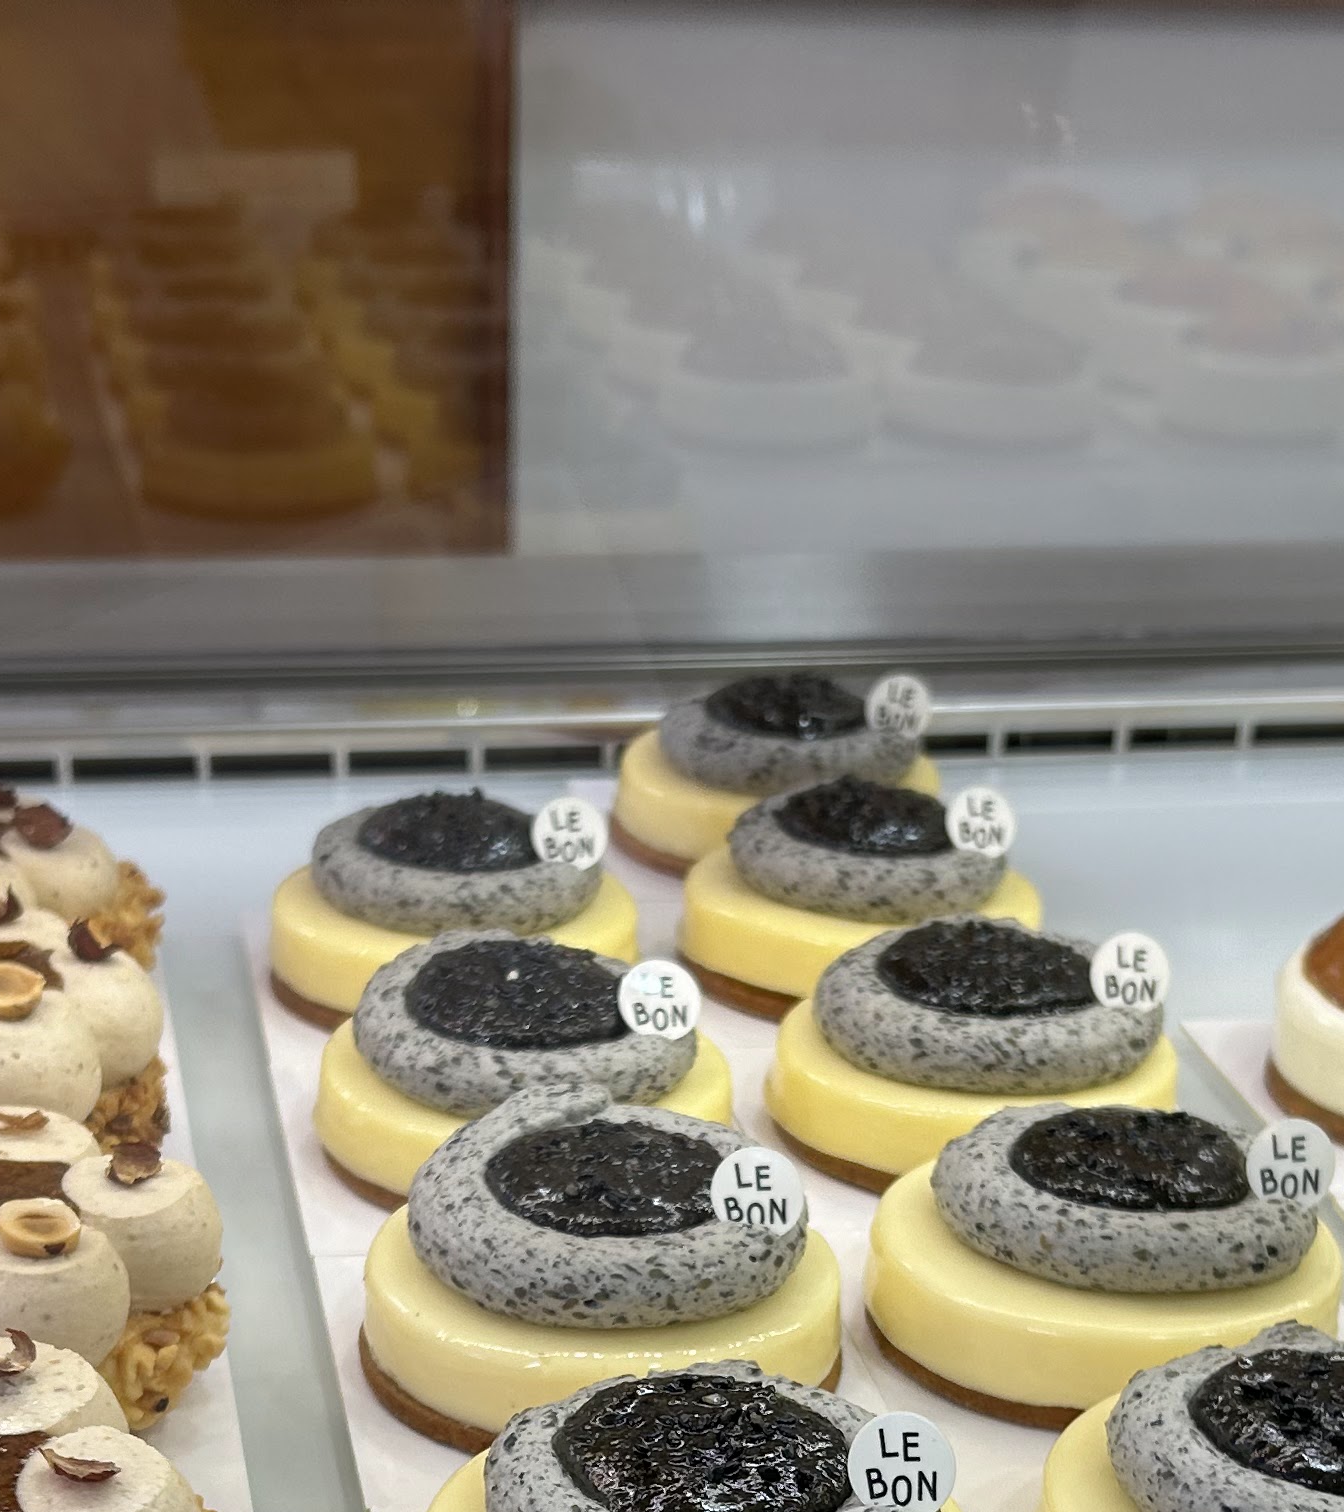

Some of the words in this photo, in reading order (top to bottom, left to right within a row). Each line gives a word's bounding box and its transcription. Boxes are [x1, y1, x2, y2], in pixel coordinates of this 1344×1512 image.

[550, 809, 582, 832] LE
[966, 795, 995, 821] LE
[959, 820, 1002, 849] BON
[543, 837, 595, 863] BON
[1117, 944, 1147, 972] LE
[1105, 975, 1156, 1005] BON
[633, 1002, 688, 1031] BON
[1270, 1133, 1306, 1163] LE
[735, 1162, 772, 1191] LE
[1260, 1167, 1320, 1199] BON
[723, 1196, 788, 1226] BON
[878, 1428, 922, 1462] LE
[865, 1467, 938, 1506] BON
